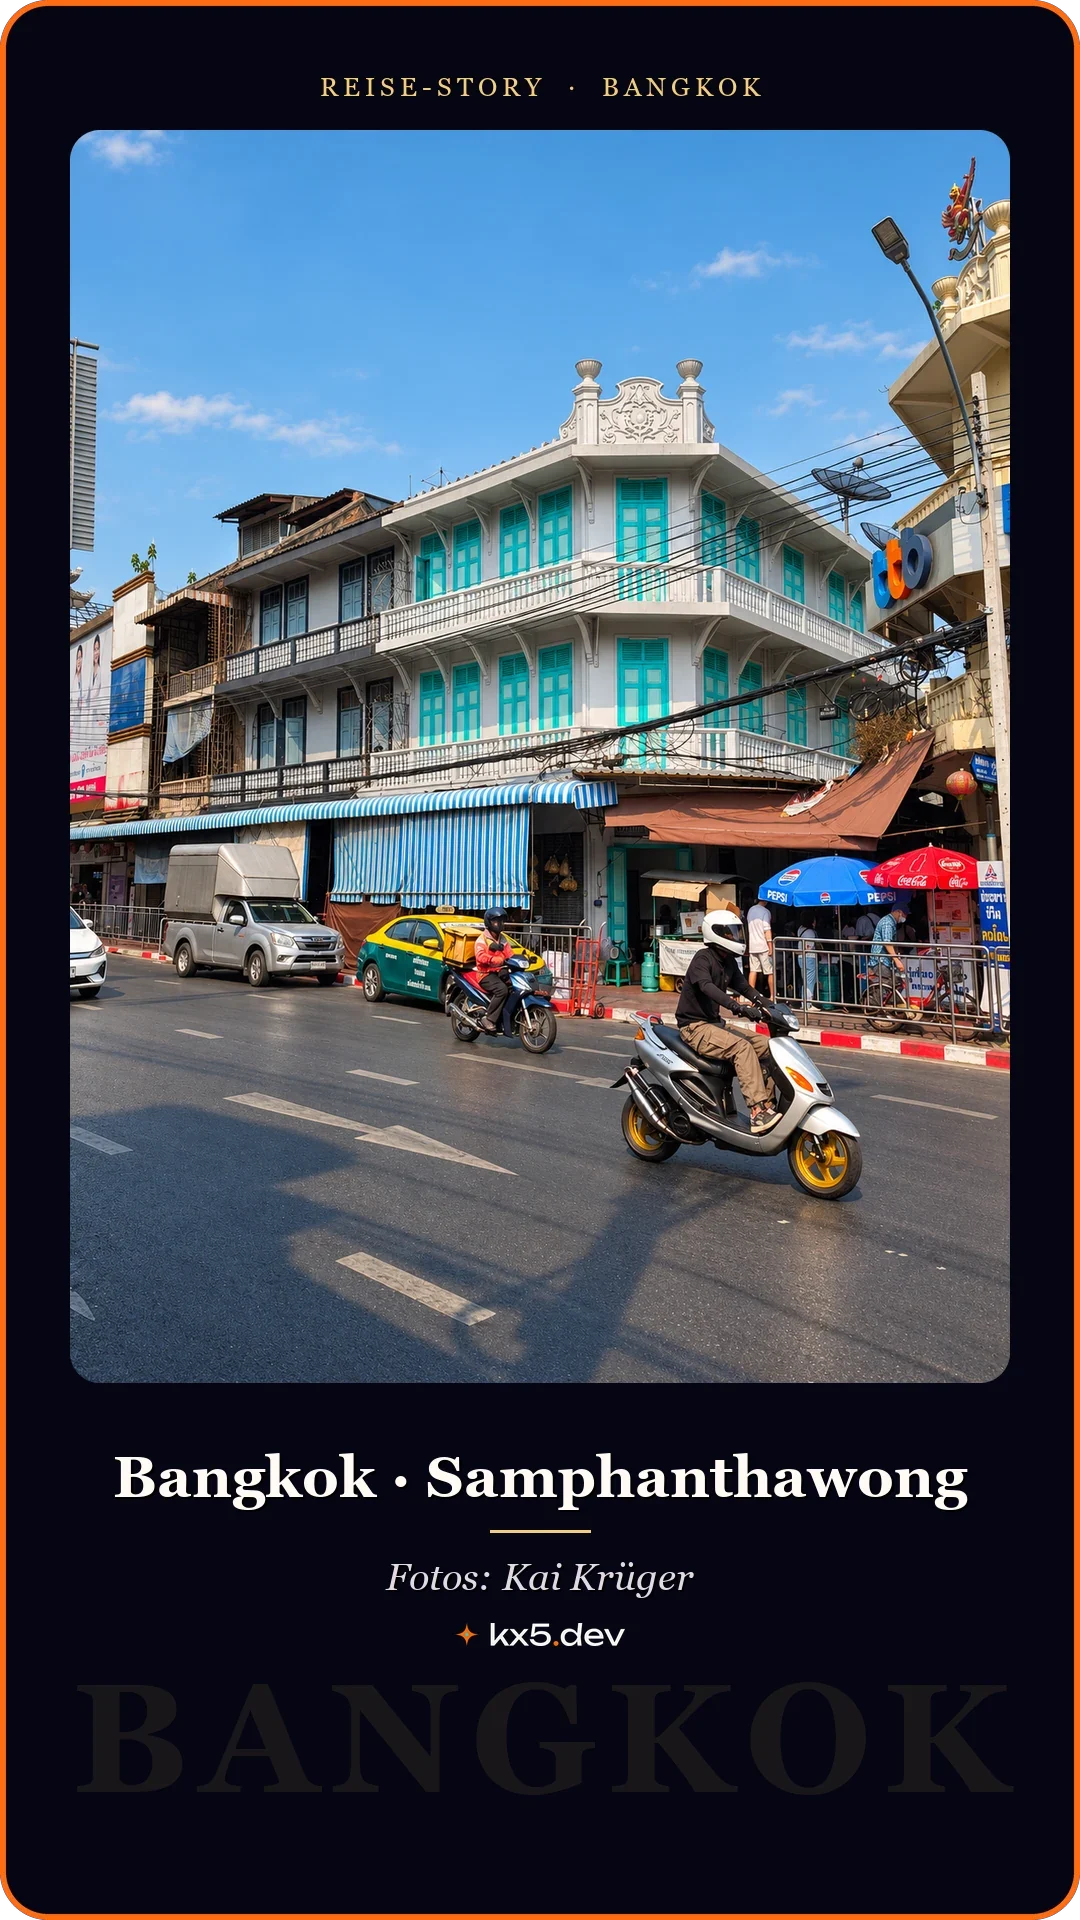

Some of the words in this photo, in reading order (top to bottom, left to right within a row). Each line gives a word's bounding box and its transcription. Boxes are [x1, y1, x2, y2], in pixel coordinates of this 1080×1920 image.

[872, 527, 934, 609] ttb
[767, 889, 788, 903] PEPSI
[867, 891, 897, 903] PEPSI
